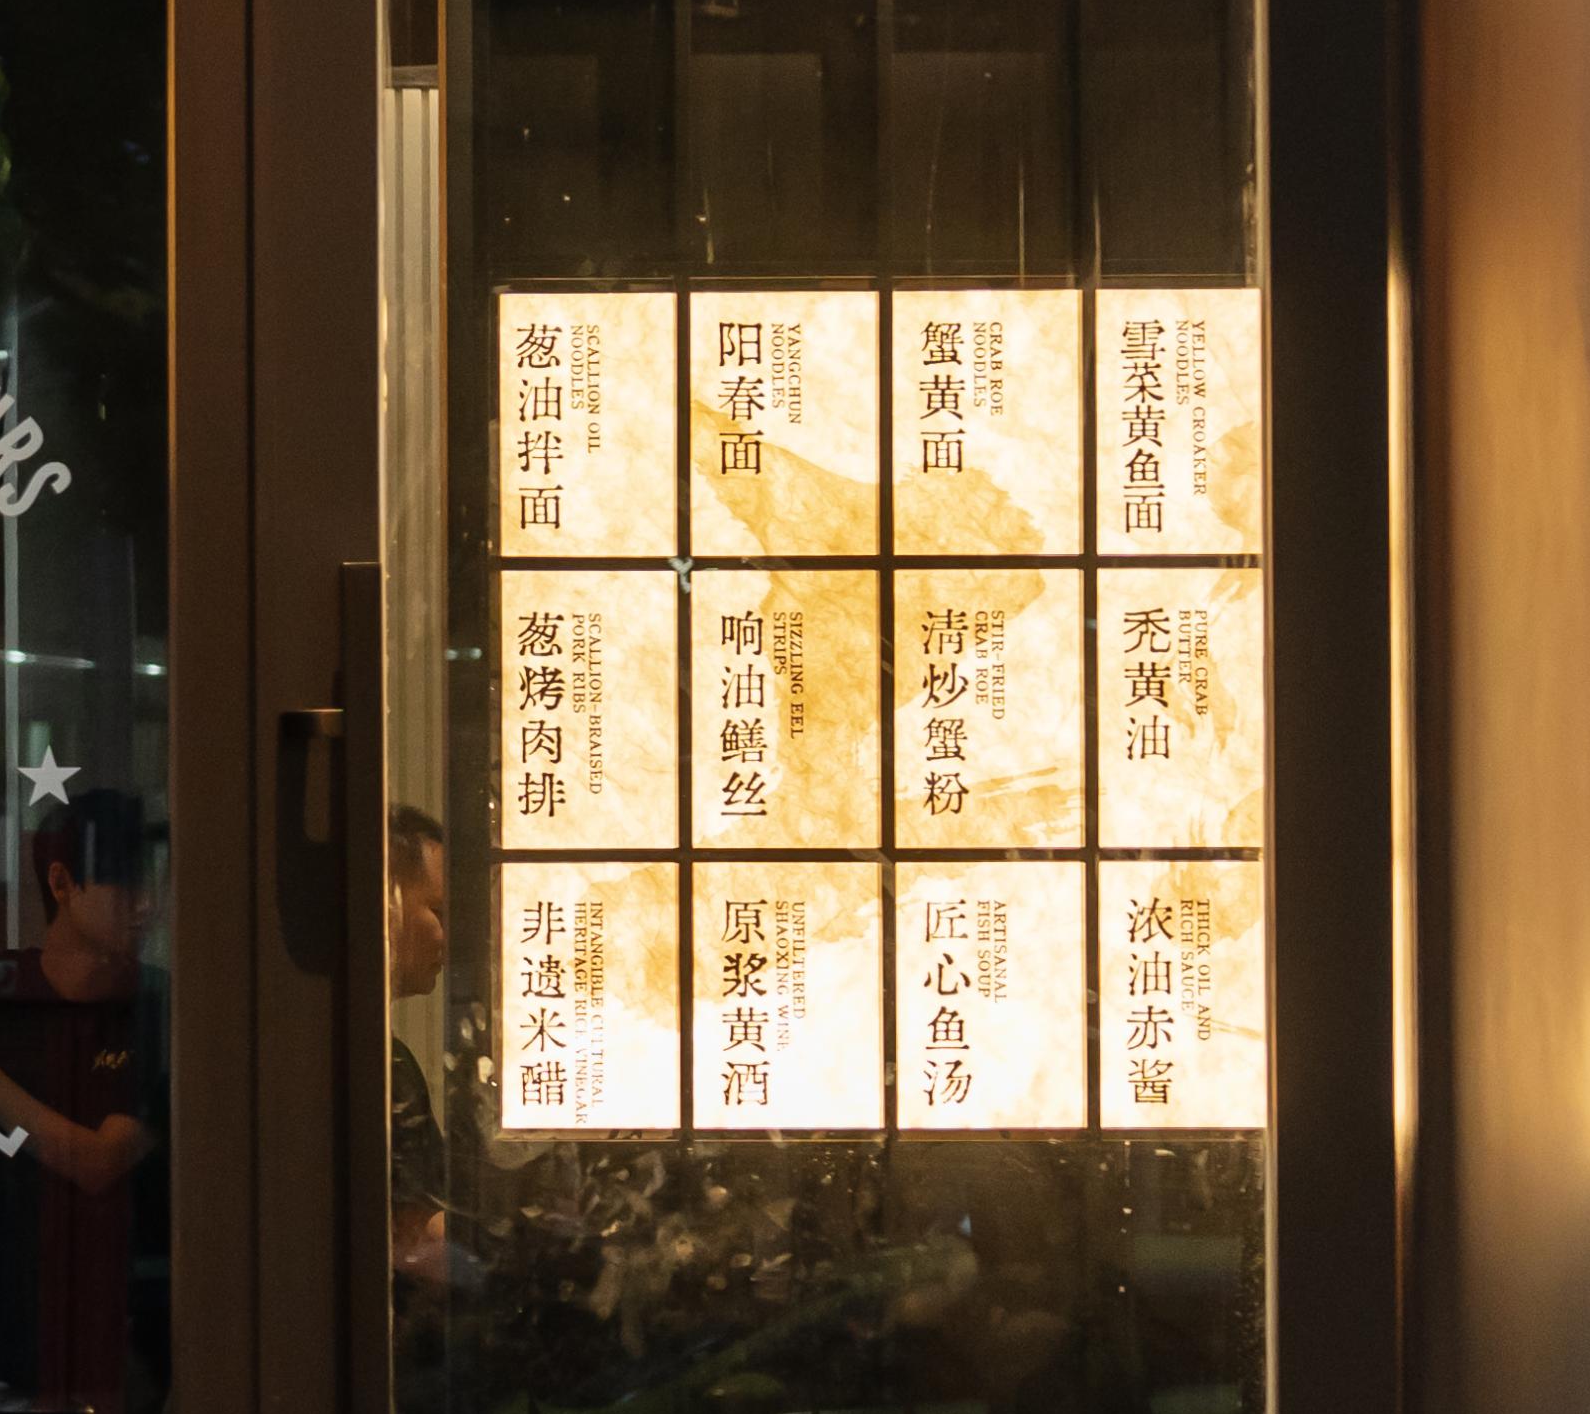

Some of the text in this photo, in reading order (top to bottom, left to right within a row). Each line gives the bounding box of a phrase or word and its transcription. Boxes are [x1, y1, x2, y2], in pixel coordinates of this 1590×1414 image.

[570, 325, 584, 410] NOODLES
[586, 324, 600, 454] SCALLION OIL
[718, 321, 766, 476] 阳春面
[772, 324, 785, 409] NOODLES
[787, 323, 801, 425] YANGCHUN
[919, 320, 966, 474] 蟹黄面
[973, 322, 987, 408] NOODLES
[989, 321, 1003, 416] CRAB ROE
[1176, 320, 1189, 406] NOODLES
[1192, 320, 1207, 496] YELLOW CROAKER
[516, 323, 564, 530] 葱油拌面
[1120, 319, 1166, 534] 雪菜黄鱼面
[572, 614, 586, 713] PORK RIBS
[773, 612, 787, 675] STRIPS
[789, 611, 804, 739] SIZZLING EEL
[975, 610, 989, 705] CRAB ROE
[991, 610, 1006, 720] STIR-FRIED
[1123, 607, 1172, 761] 秃黄油
[1178, 610, 1191, 684] BUTTER
[1194, 610, 1208, 716] PURE CRAB
[517, 611, 566, 818] 葱烤肉排
[588, 613, 604, 795] SCALLION-BRAISED
[720, 610, 768, 817] 响油鳝丝
[921, 608, 969, 816] 清炒蟹粉
[520, 900, 568, 1106] 非遗米醋
[574, 902, 588, 992] HERITAGE
[590, 902, 604, 1008] INTANGIBLE
[721, 899, 769, 1107] 原浆黄酒
[775, 901, 789, 996] SHAOXING
[791, 901, 806, 1019] UNFILTERED
[923, 899, 972, 1107] 匠心鱼汤
[977, 900, 991, 998] FISH SOUP
[993, 900, 1007, 1003] ARTISANAL
[1127, 897, 1174, 1104] 浓油赤酱
[1180, 899, 1194, 1011] RICH SAUCE
[1197, 898, 1211, 1041] THICK OIL AND
